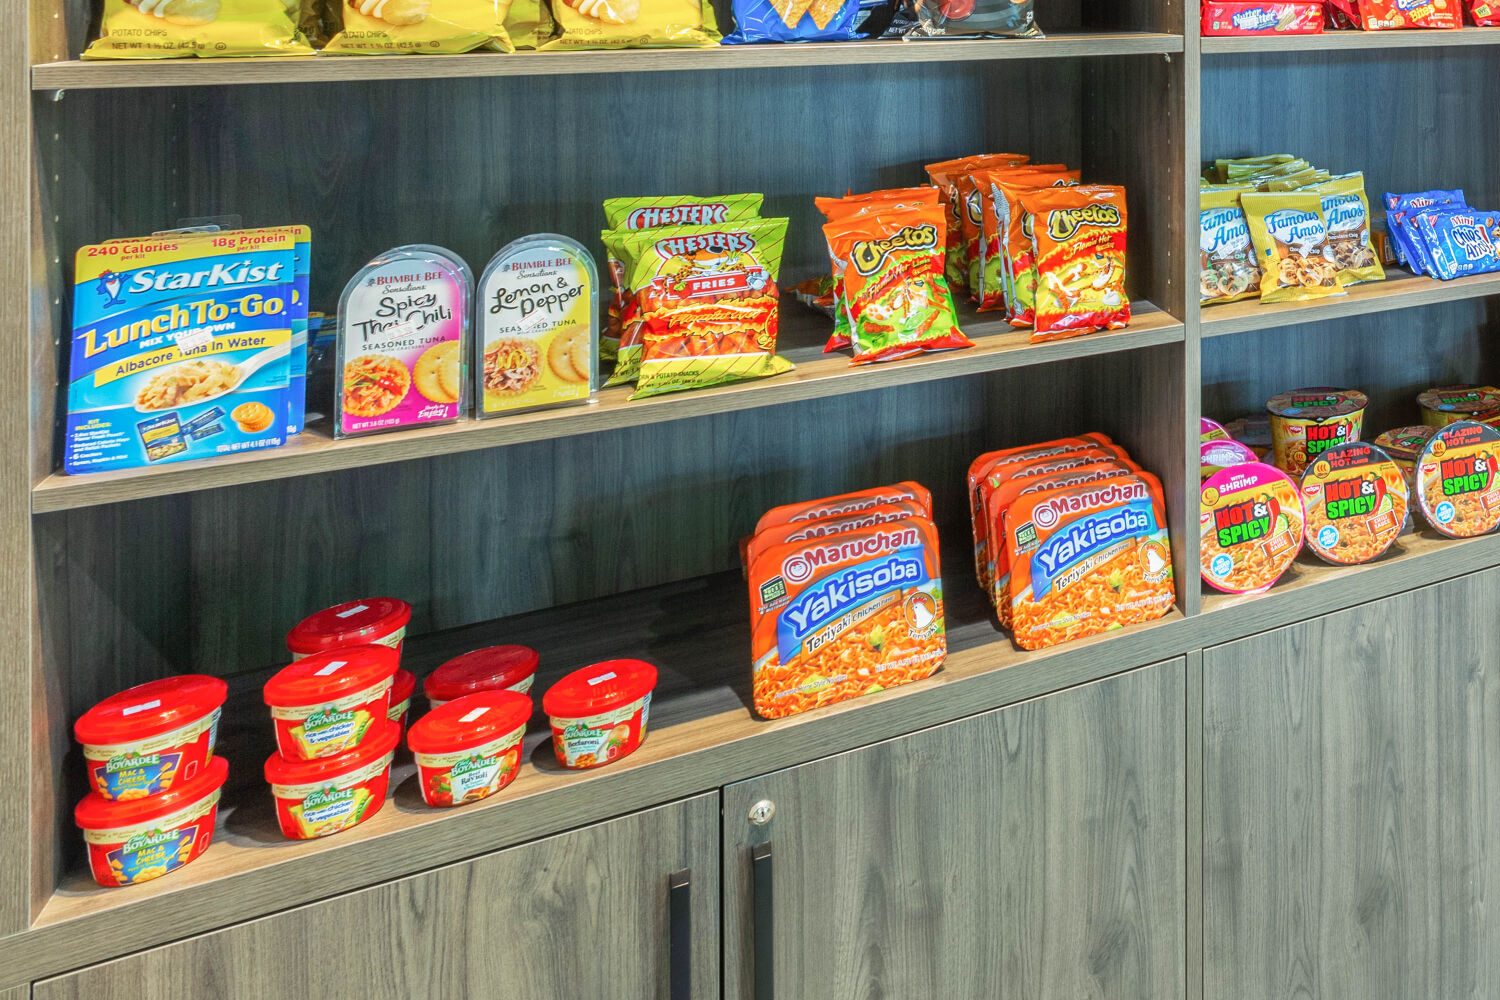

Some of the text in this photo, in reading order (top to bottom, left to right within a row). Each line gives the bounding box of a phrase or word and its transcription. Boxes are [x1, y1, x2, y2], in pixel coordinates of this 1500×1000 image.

[1408, 5, 1436, 22] Bites
[112, 29, 168, 38] POTATO CHIPS
[112, 42, 143, 50] NET WT
[1052, 206, 1118, 238] Cheetos
[1264, 210, 1320, 234] Famous
[1327, 207, 1364, 231] Amos
[1450, 215, 1474, 227] Mini
[211, 233, 286, 248] 18g Protein
[1285, 223, 1324, 244] Amos
[1452, 227, 1481, 247] Chips
[88, 242, 179, 257] 240 Calories
[656, 232, 755, 259] CHESTER'S
[854, 227, 934, 272] Cheetos
[511, 257, 573, 272] BUMBLE BEE
[129, 259, 284, 294] StarKist
[377, 271, 443, 286] BUMBLE BEE
[692, 278, 736, 291] FRIES
[490, 276, 569, 315] Lemon &
[520, 284, 586, 318] Pepper
[376, 293, 437, 318] Spicy
[362, 335, 446, 351] SEASONED TUNA
[115, 351, 174, 377] Albacore
[211, 338, 223, 351] In
[228, 335, 267, 349] Water
[1307, 425, 1346, 441] HOT &
[1327, 447, 1371, 461] BLAZING
[1330, 457, 1351, 468] HOT
[1219, 475, 1258, 493] SHRIMP
[1230, 473, 1246, 482] WITH
[1443, 473, 1489, 496] SPICY
[1051, 484, 1145, 515] Maruchan
[1327, 495, 1377, 520] SPICY
[1218, 515, 1270, 547] SPICY
[804, 530, 917, 566] Maruchan
[1040, 512, 1148, 573] Yakisoba
[1143, 569, 1170, 584] Teriyaki
[789, 561, 918, 632] Yakisoba
[908, 623, 938, 640] Teriyaki
[304, 711, 355, 731] BOYARDEE
[308, 712, 322, 722] Chef
[564, 726, 576, 734] Chef
[564, 729, 603, 739] BOYARDEE
[567, 739, 600, 749] Beefaroni
[454, 760, 470, 770] Chef
[118, 775, 146, 786] CHEESE
[119, 770, 137, 779] MAC
[461, 772, 488, 786] Ravioli
[468, 770, 481, 778] Beef
[136, 852, 165, 865] CHEESE
[138, 848, 156, 858] MAC
